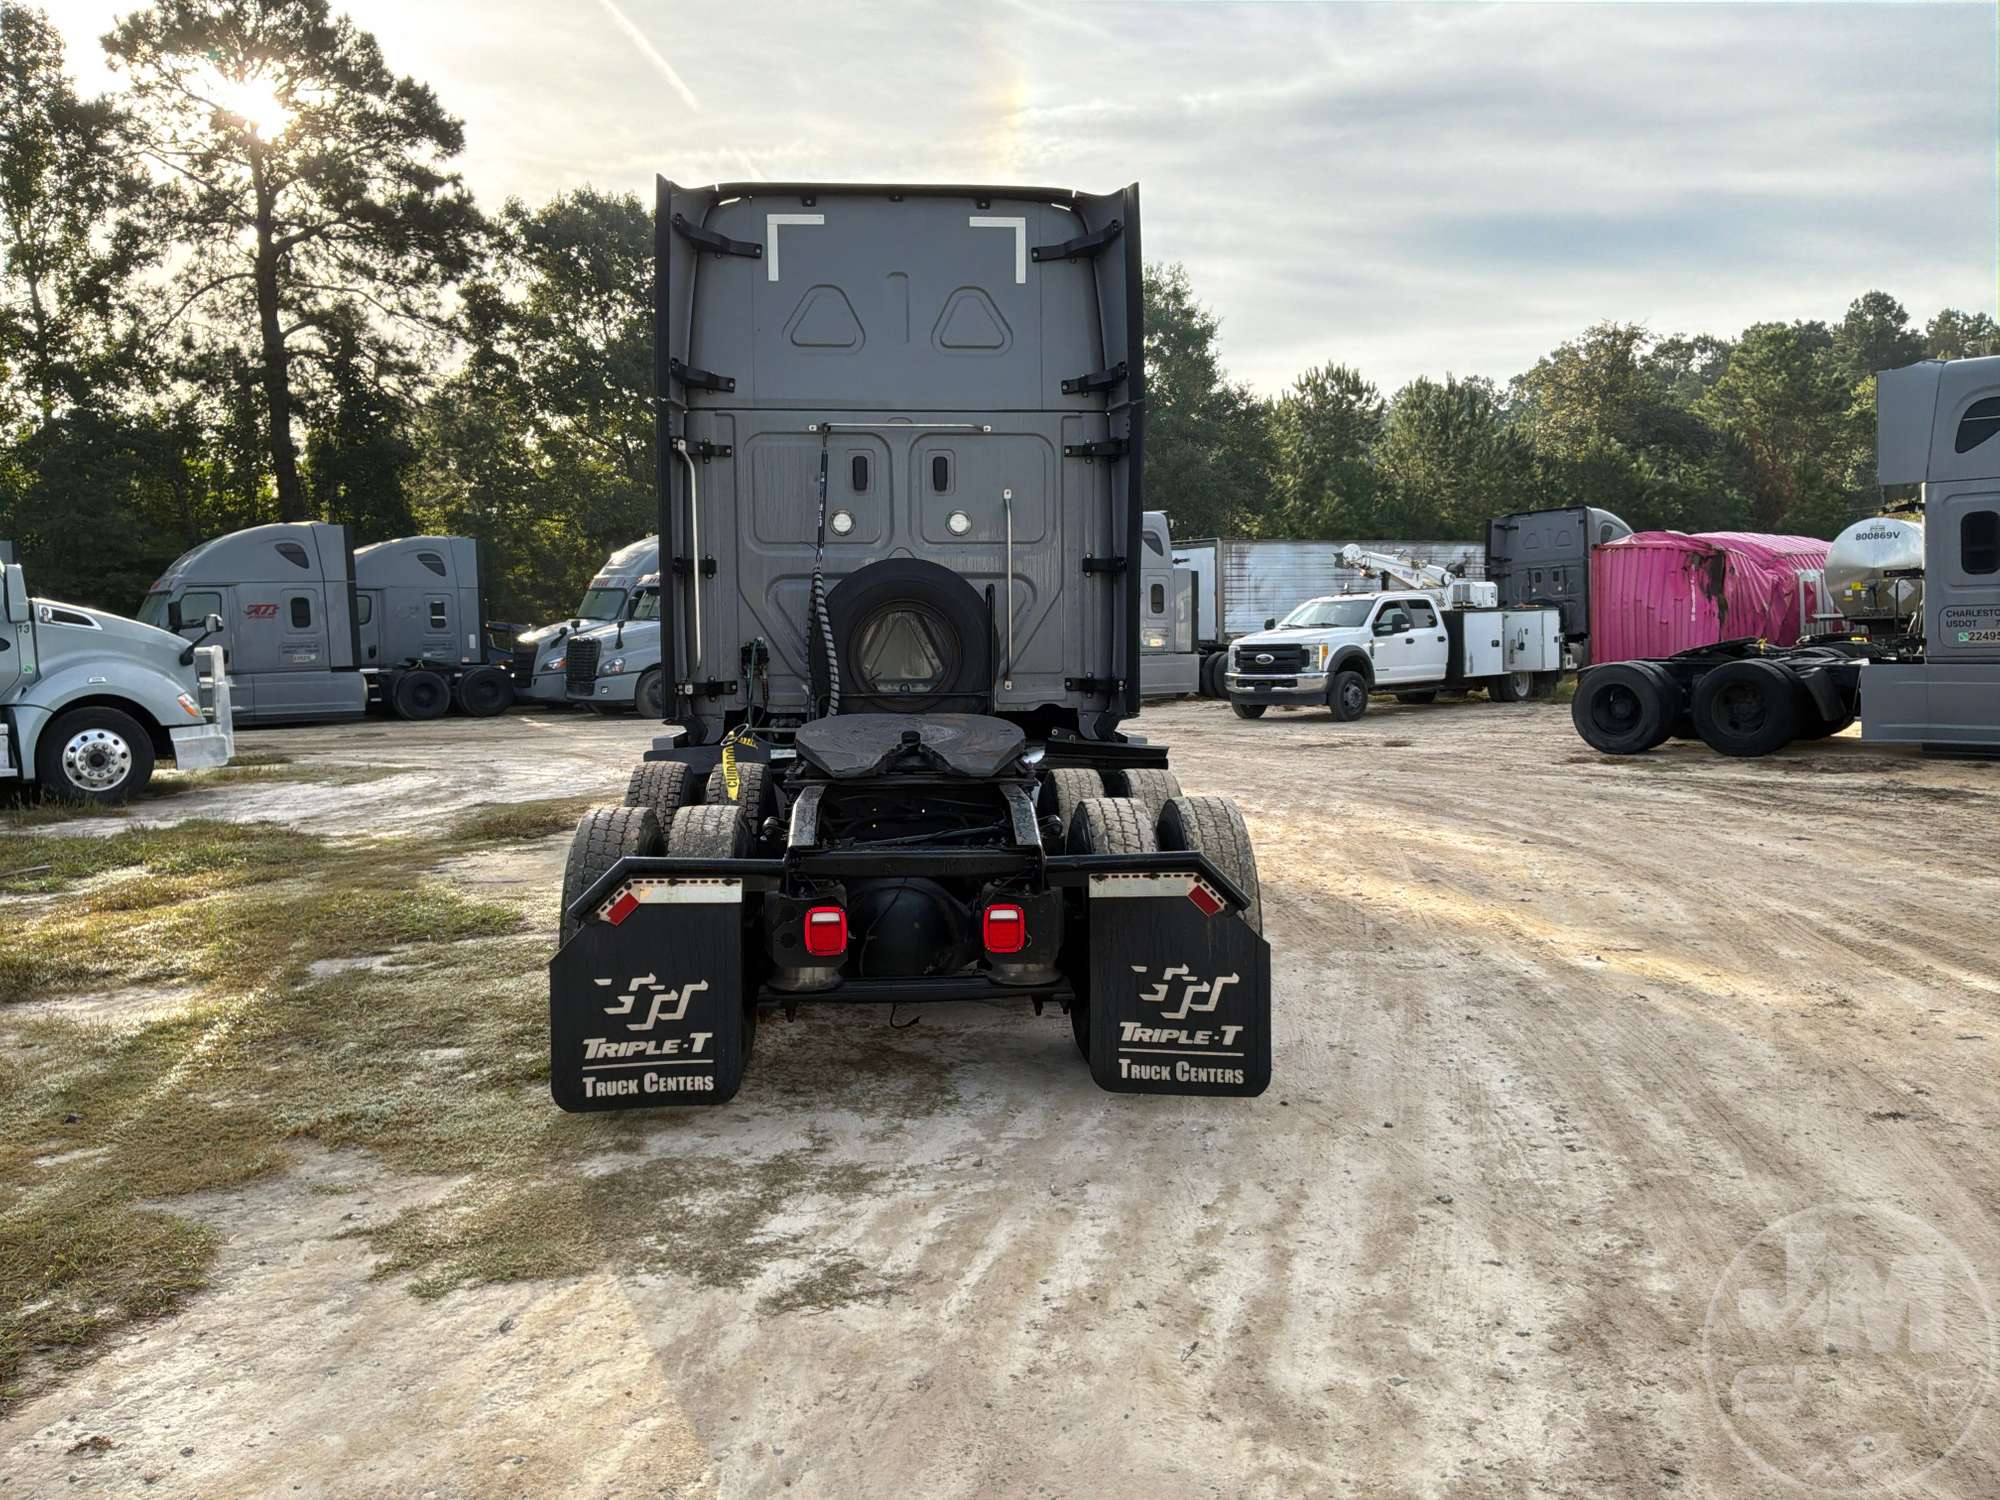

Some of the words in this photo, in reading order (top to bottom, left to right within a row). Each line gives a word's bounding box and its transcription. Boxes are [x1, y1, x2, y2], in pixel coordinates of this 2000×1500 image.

[1855, 531, 1901, 541] 800869V
[1946, 619, 1977, 628] USDOT
[583, 1032, 713, 1060] TRIPLE-T
[1120, 1021, 1244, 1046] TRIPLE-T
[1118, 1058, 1171, 1080] TRUCK
[1175, 1060, 1245, 1084] CENTERS
[582, 1076, 639, 1098] TRUCK
[643, 1071, 715, 1093] CENTERS
